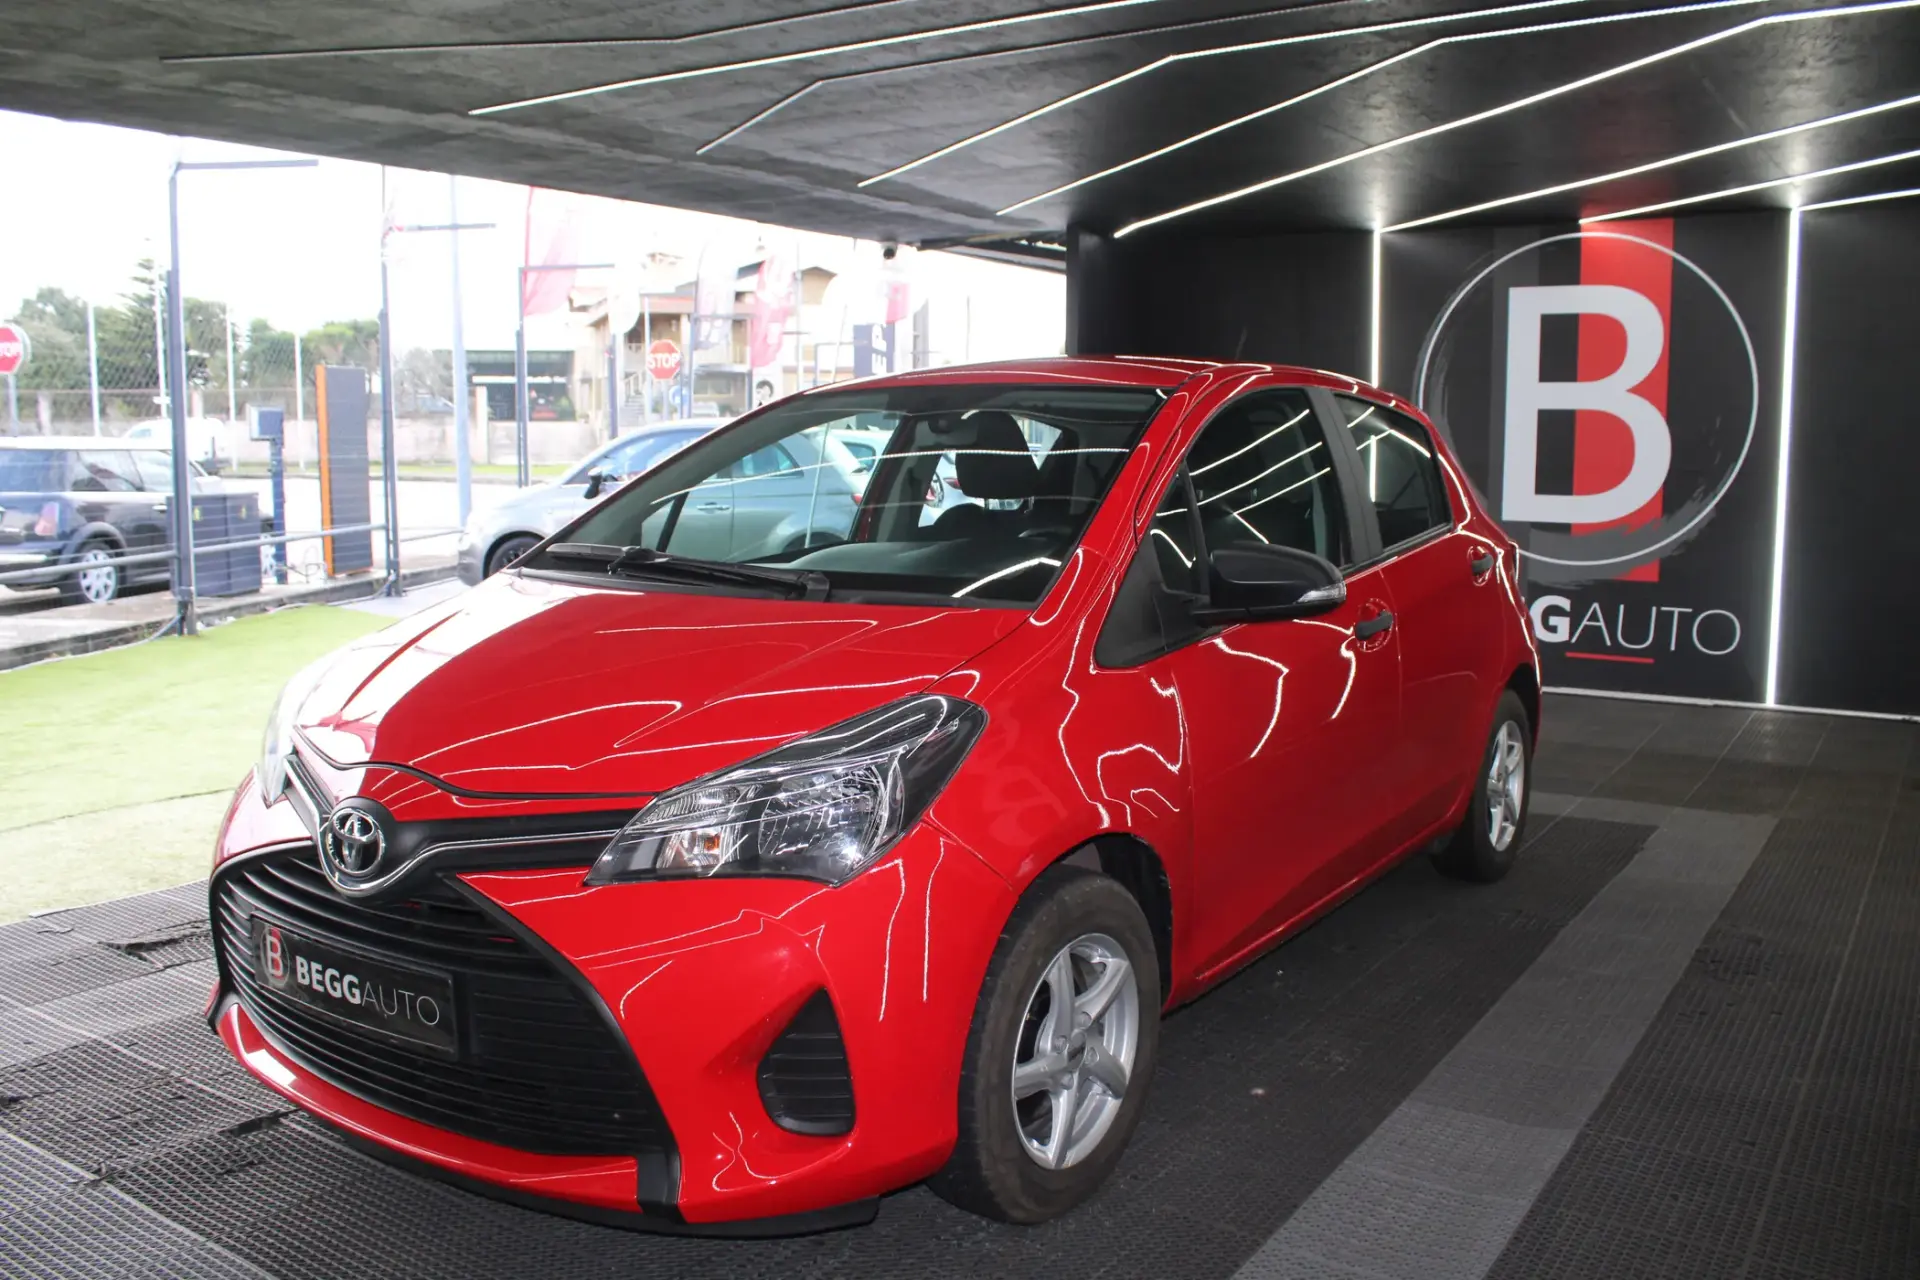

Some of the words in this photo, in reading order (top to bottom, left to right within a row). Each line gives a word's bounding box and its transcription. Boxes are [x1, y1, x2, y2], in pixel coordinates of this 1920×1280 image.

[646, 352, 680, 369] STOP
[1502, 284, 1671, 523] B
[1529, 595, 1741, 655] GAUTO
[266, 935, 284, 977] B
[295, 955, 439, 1026] BEGGAUTO
